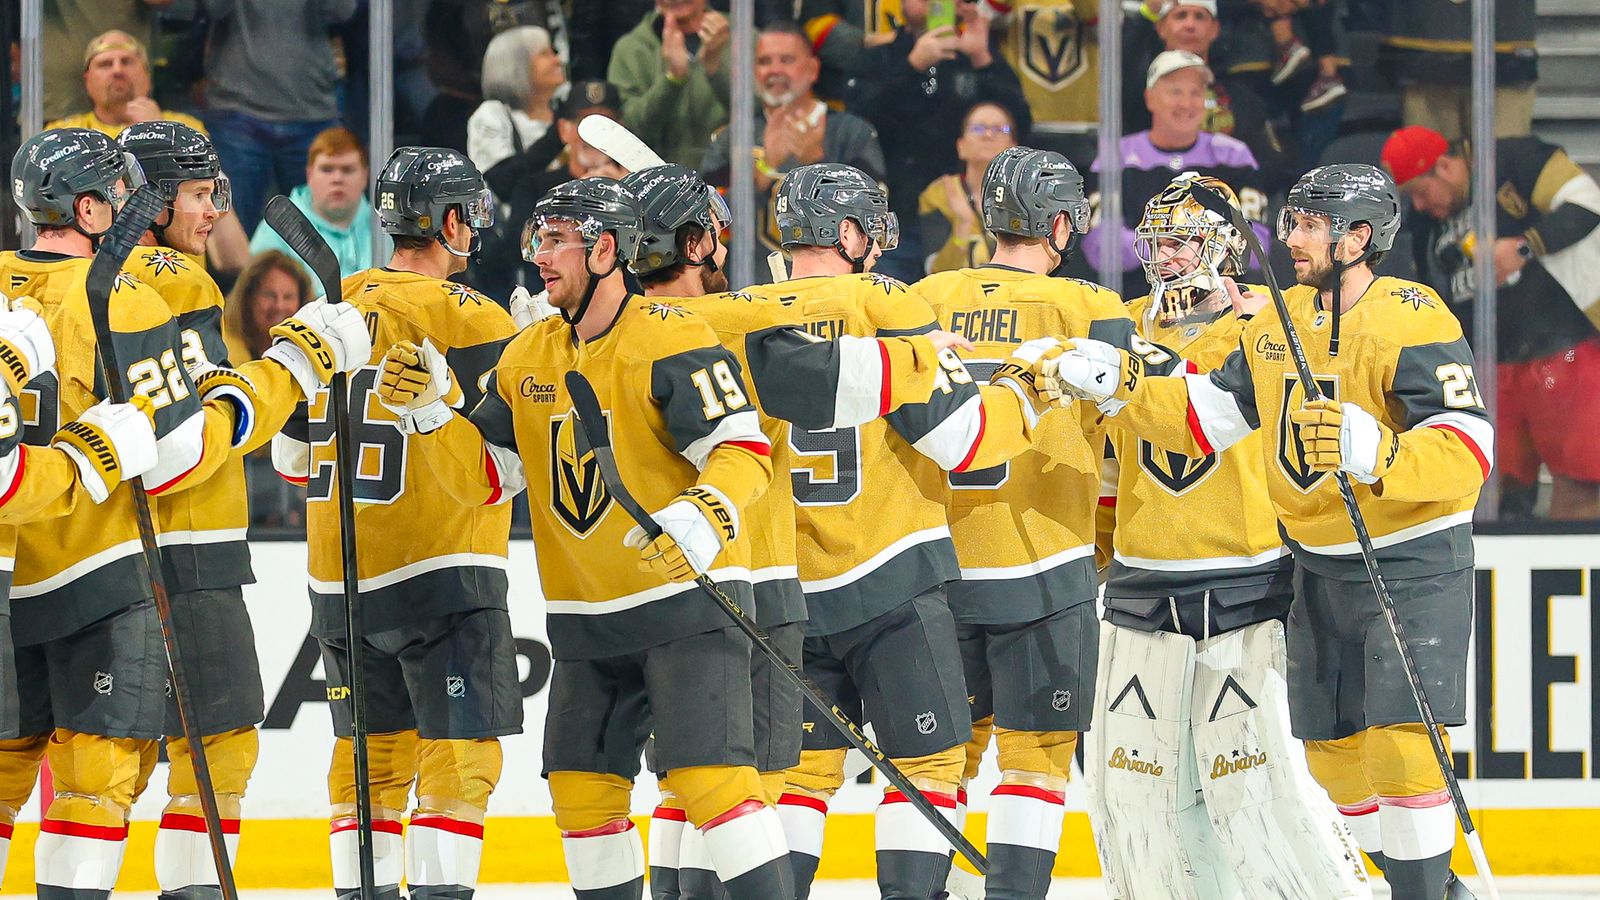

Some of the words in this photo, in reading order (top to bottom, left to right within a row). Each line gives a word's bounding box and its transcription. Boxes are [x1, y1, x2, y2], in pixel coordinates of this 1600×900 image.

[381, 192, 395, 210] 26
[995, 186, 1004, 203] 9
[951, 308, 1022, 343] EICHEL
[1256, 333, 1288, 354] Circa
[1265, 350, 1286, 363] SPORTS
[520, 376, 556, 398] Circa
[532, 393, 556, 403] SPORTS
[690, 359, 748, 421] 19
[831, 704, 886, 762] CCM
[1107, 746, 1164, 777] Brian's
[1209, 746, 1267, 780] Brian's
